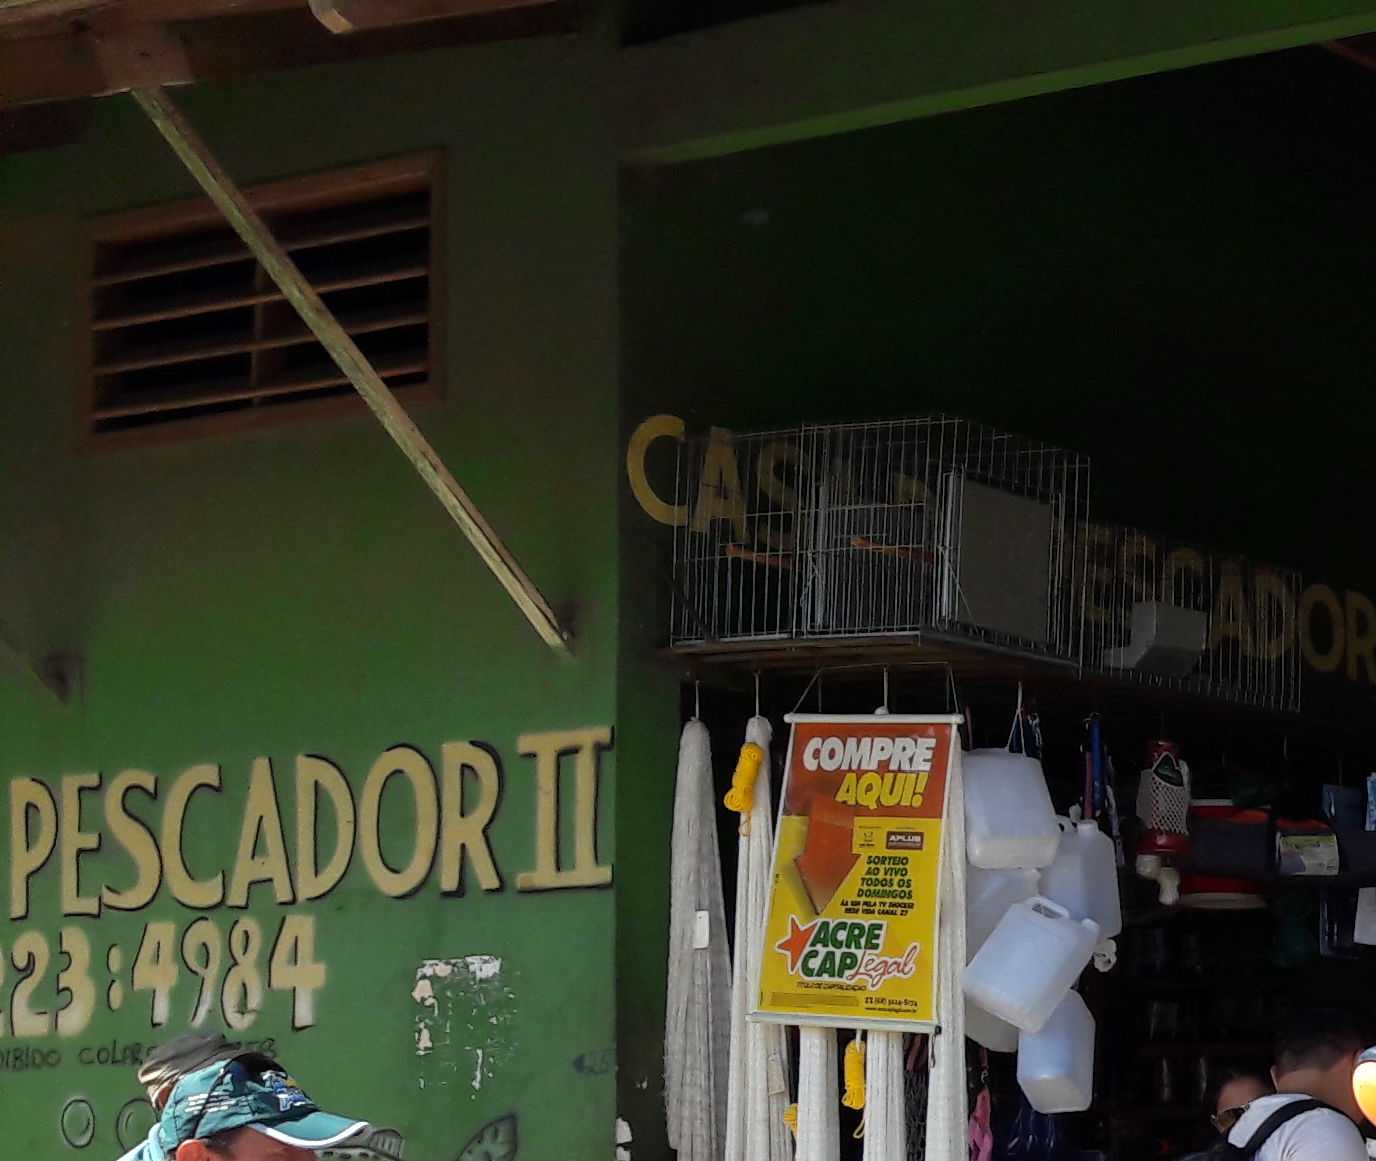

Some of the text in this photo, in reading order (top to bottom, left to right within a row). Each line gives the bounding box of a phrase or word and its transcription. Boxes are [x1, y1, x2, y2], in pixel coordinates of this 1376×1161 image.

[802, 736, 937, 772] COMPRE
[834, 772, 929, 810] AQUI!
[9, 726, 615, 921] PESCADOR II
[865, 866, 908, 877] AO VIVO
[866, 855, 909, 866] SORTEIO
[857, 887, 913, 900] DOMINGOS
[860, 877, 912, 889] TODOS OS
[809, 920, 884, 950] ACRE
[0, 916, 327, 1038] 23:4984
[801, 944, 919, 988] CAP Legal
